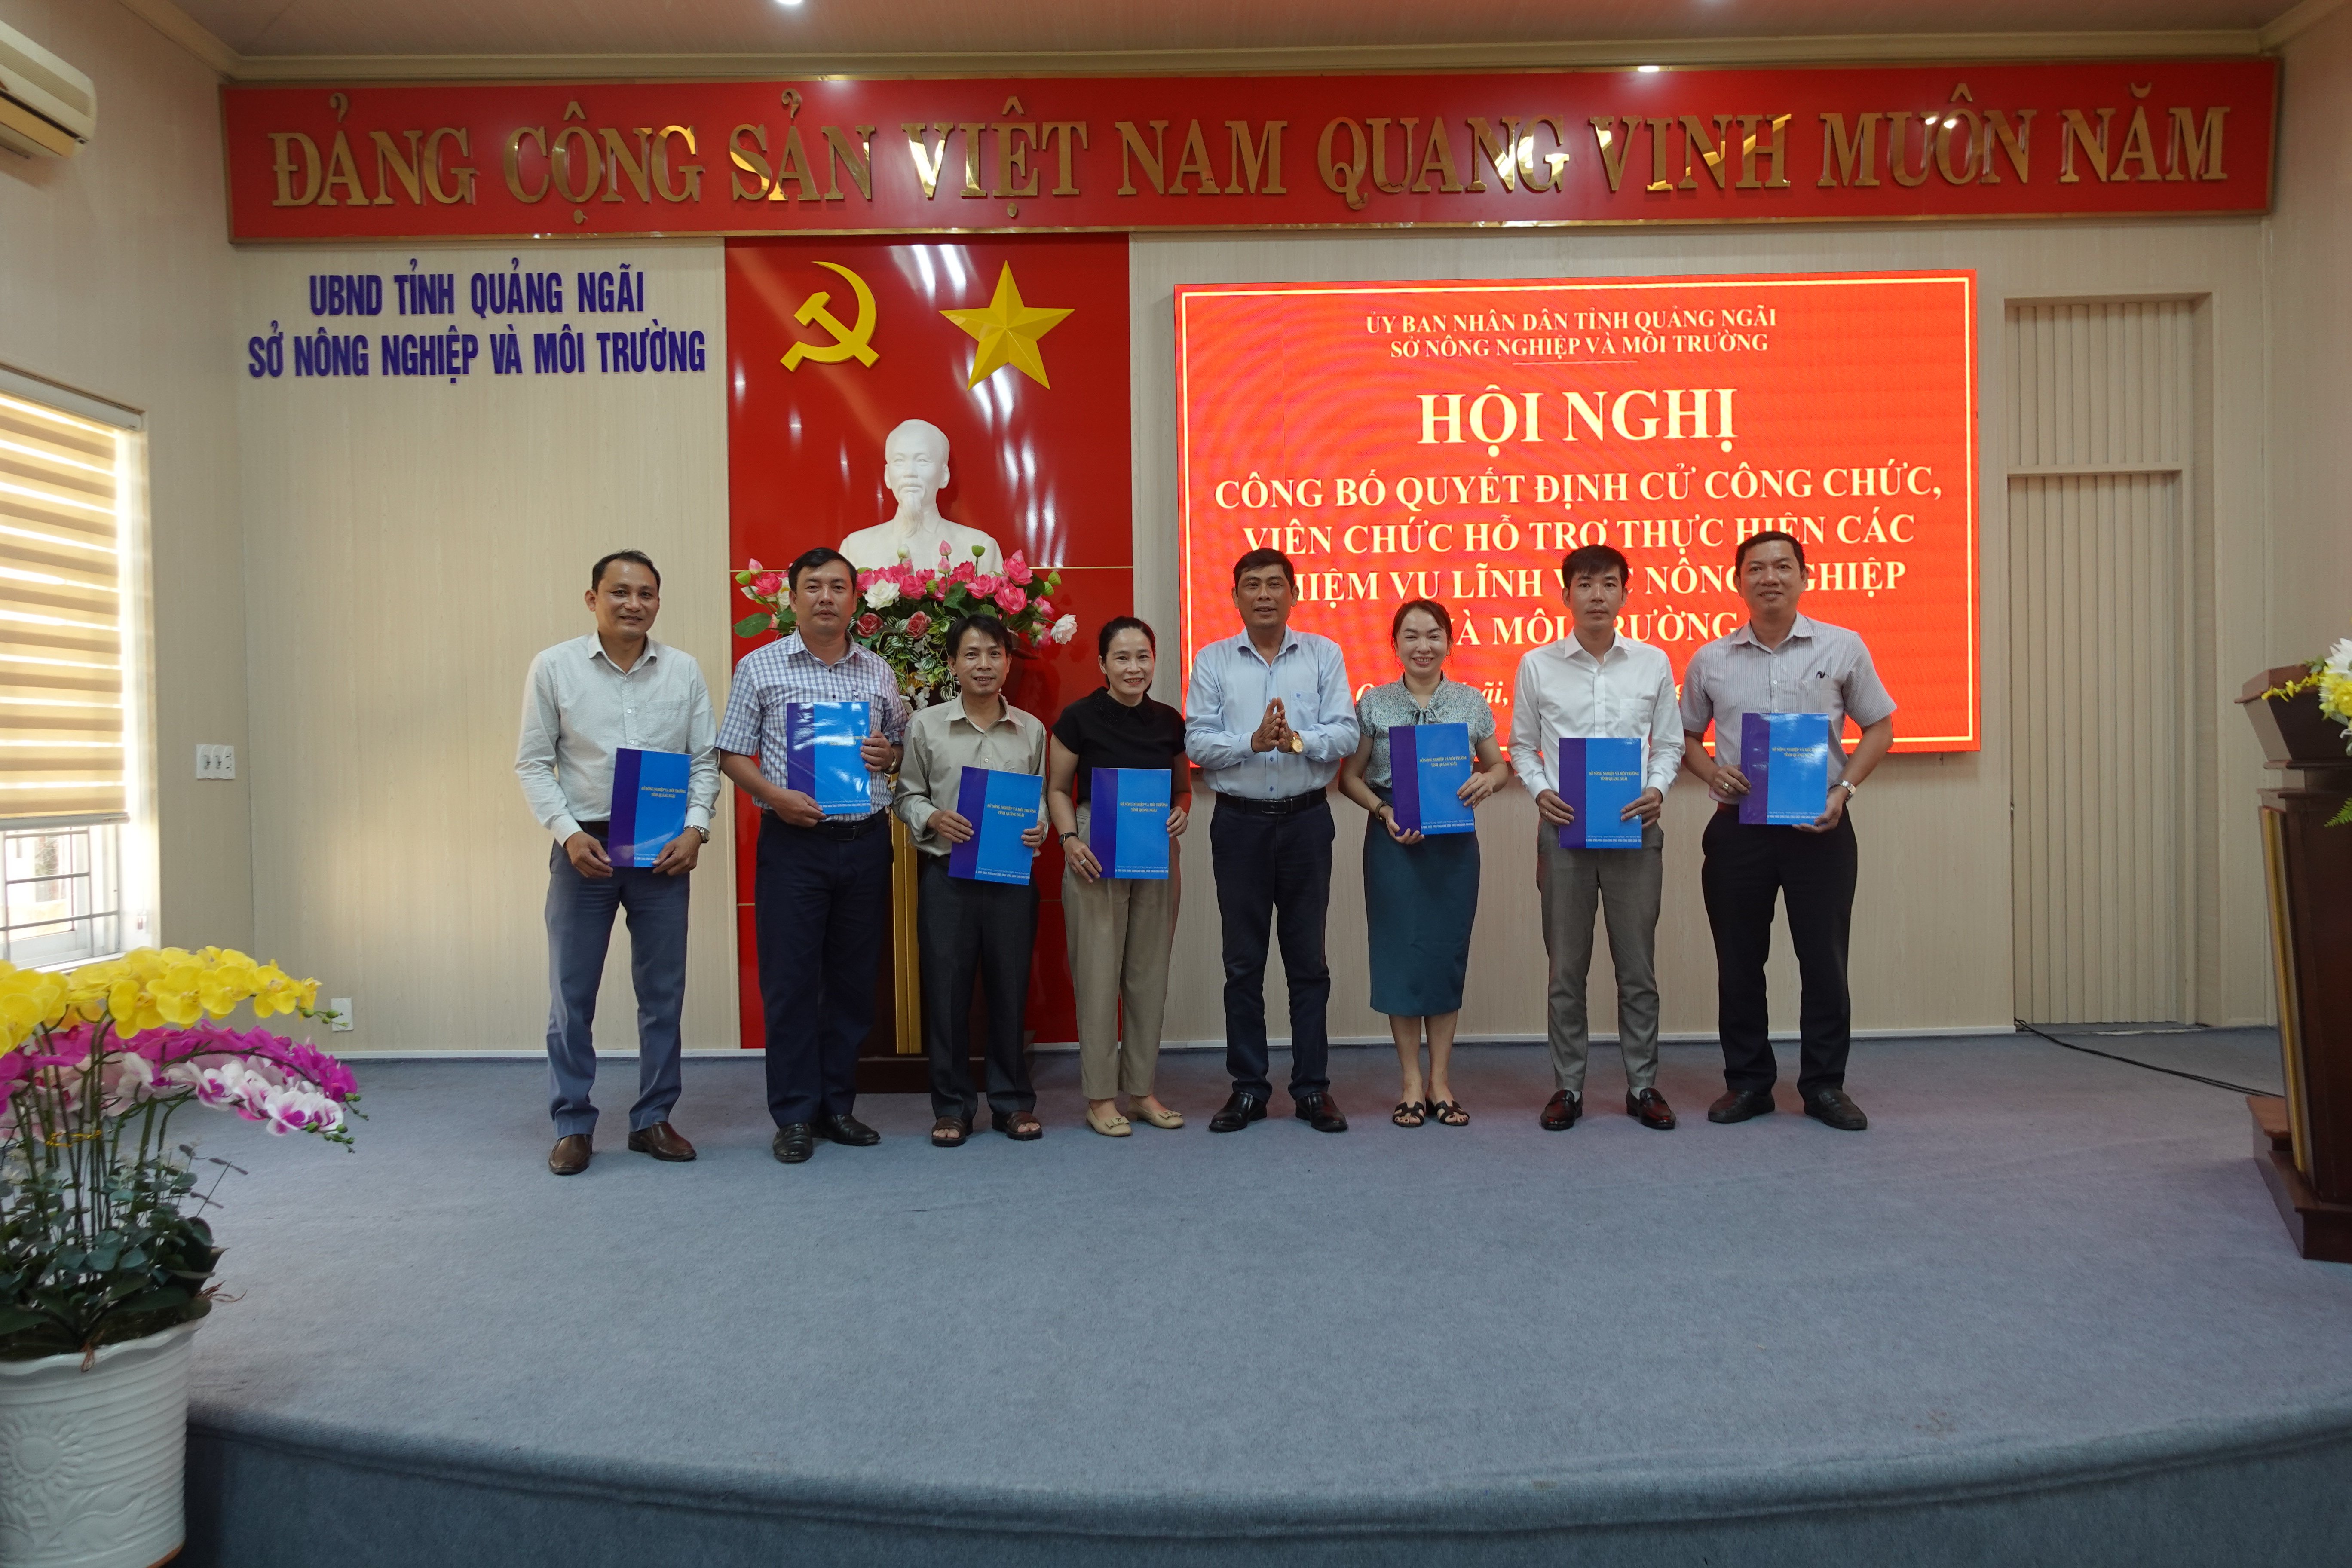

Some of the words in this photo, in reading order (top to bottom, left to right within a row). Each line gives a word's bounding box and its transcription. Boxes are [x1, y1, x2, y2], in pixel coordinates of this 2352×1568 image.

[268, 93, 479, 207] ĐẢNG
[504, 101, 705, 224] CỘNG
[729, 88, 876, 202] SẢN
[901, 96, 1088, 217] VIỆT
[1115, 119, 1288, 196] NAM
[1317, 116, 1570, 210] QUANG
[1589, 113, 1792, 191] VINH
[1818, 83, 2037, 187] MUÔN
[2058, 82, 2230, 183] NĂM
[309, 274, 383, 316] UBND
[394, 258, 455, 315] TỈNH
[471, 257, 563, 320] QUẢNG
[577, 263, 644, 314] NGÃI
[1366, 311, 1396, 334] ỦY
[1402, 315, 1447, 333] BAN
[1453, 309, 1515, 332] NHÂN
[1522, 308, 1568, 331] DÂN
[1573, 308, 1629, 330] TỈNH
[1634, 306, 1715, 331] QUẢNG
[1721, 305, 1776, 327] NGÃI
[248, 320, 284, 378] SỞ
[294, 326, 369, 377] NÔNG
[381, 325, 479, 384] NGHIỆP
[489, 324, 523, 374] VÀ
[533, 323, 585, 374] MÔI
[596, 318, 706, 373] TRƯỜNG
[1390, 337, 1420, 358] SỞ
[1425, 333, 1490, 357] NÔNG
[1496, 337, 1581, 360] NGHIỆP
[1586, 331, 1617, 354] VÀ
[1622, 330, 1668, 354] MÔI
[1677, 330, 1768, 353] TRƯỜNG
[1416, 384, 1544, 457] HỘI
[1562, 388, 1738, 453] NGHỊ
[1215, 472, 1323, 508] CÔNG
[1335, 469, 1386, 507] BỐ
[1396, 467, 1525, 511] QUYẾT
[1534, 473, 1629, 510] ĐỊNH
[1639, 462, 1696, 501] CỬ
[1704, 462, 1813, 499] CÔNG
[1822, 459, 1942, 499] CHỨC,
[1243, 518, 1332, 554] VIÊN
[1343, 515, 1452, 554] CHỨC
[1464, 514, 1520, 551] HỖ
[1616, 514, 1724, 555] THỰC
[1836, 506, 1915, 544] CÁC
[1452, 562, 1543, 598] LĨNH
[1450, 609, 1481, 646] À
[1492, 608, 1567, 644] MÔI
[1614, 605, 1739, 642] RƯỜNG
